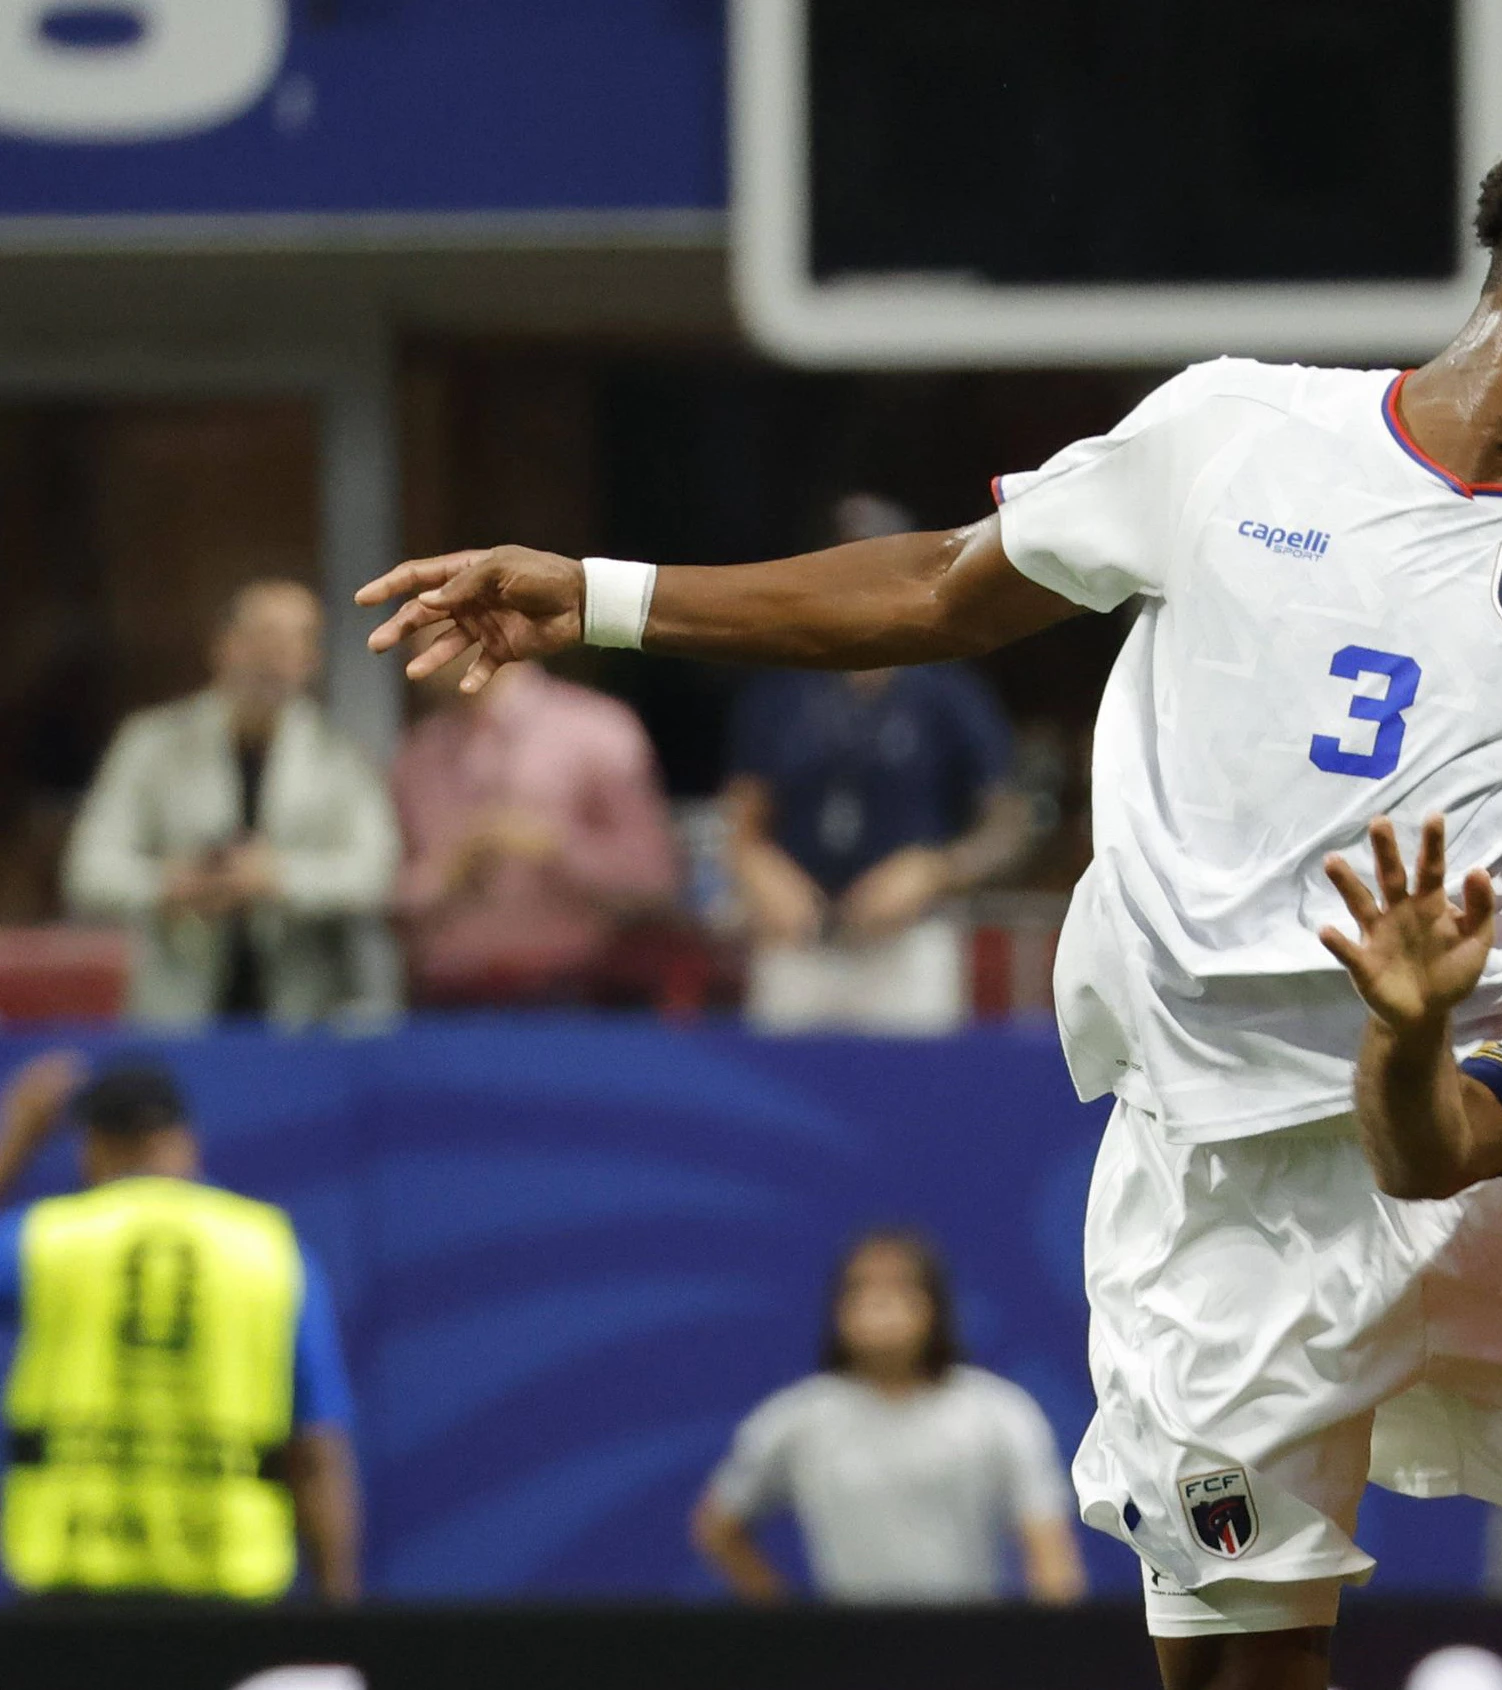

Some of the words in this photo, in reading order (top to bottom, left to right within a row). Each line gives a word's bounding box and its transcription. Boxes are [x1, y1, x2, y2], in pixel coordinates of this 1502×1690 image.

[1238, 520, 1331, 554] capelli
[1273, 545, 1323, 562] SPORT
[1309, 644, 1422, 780] 3
[1186, 1474, 1239, 1498] FCF
